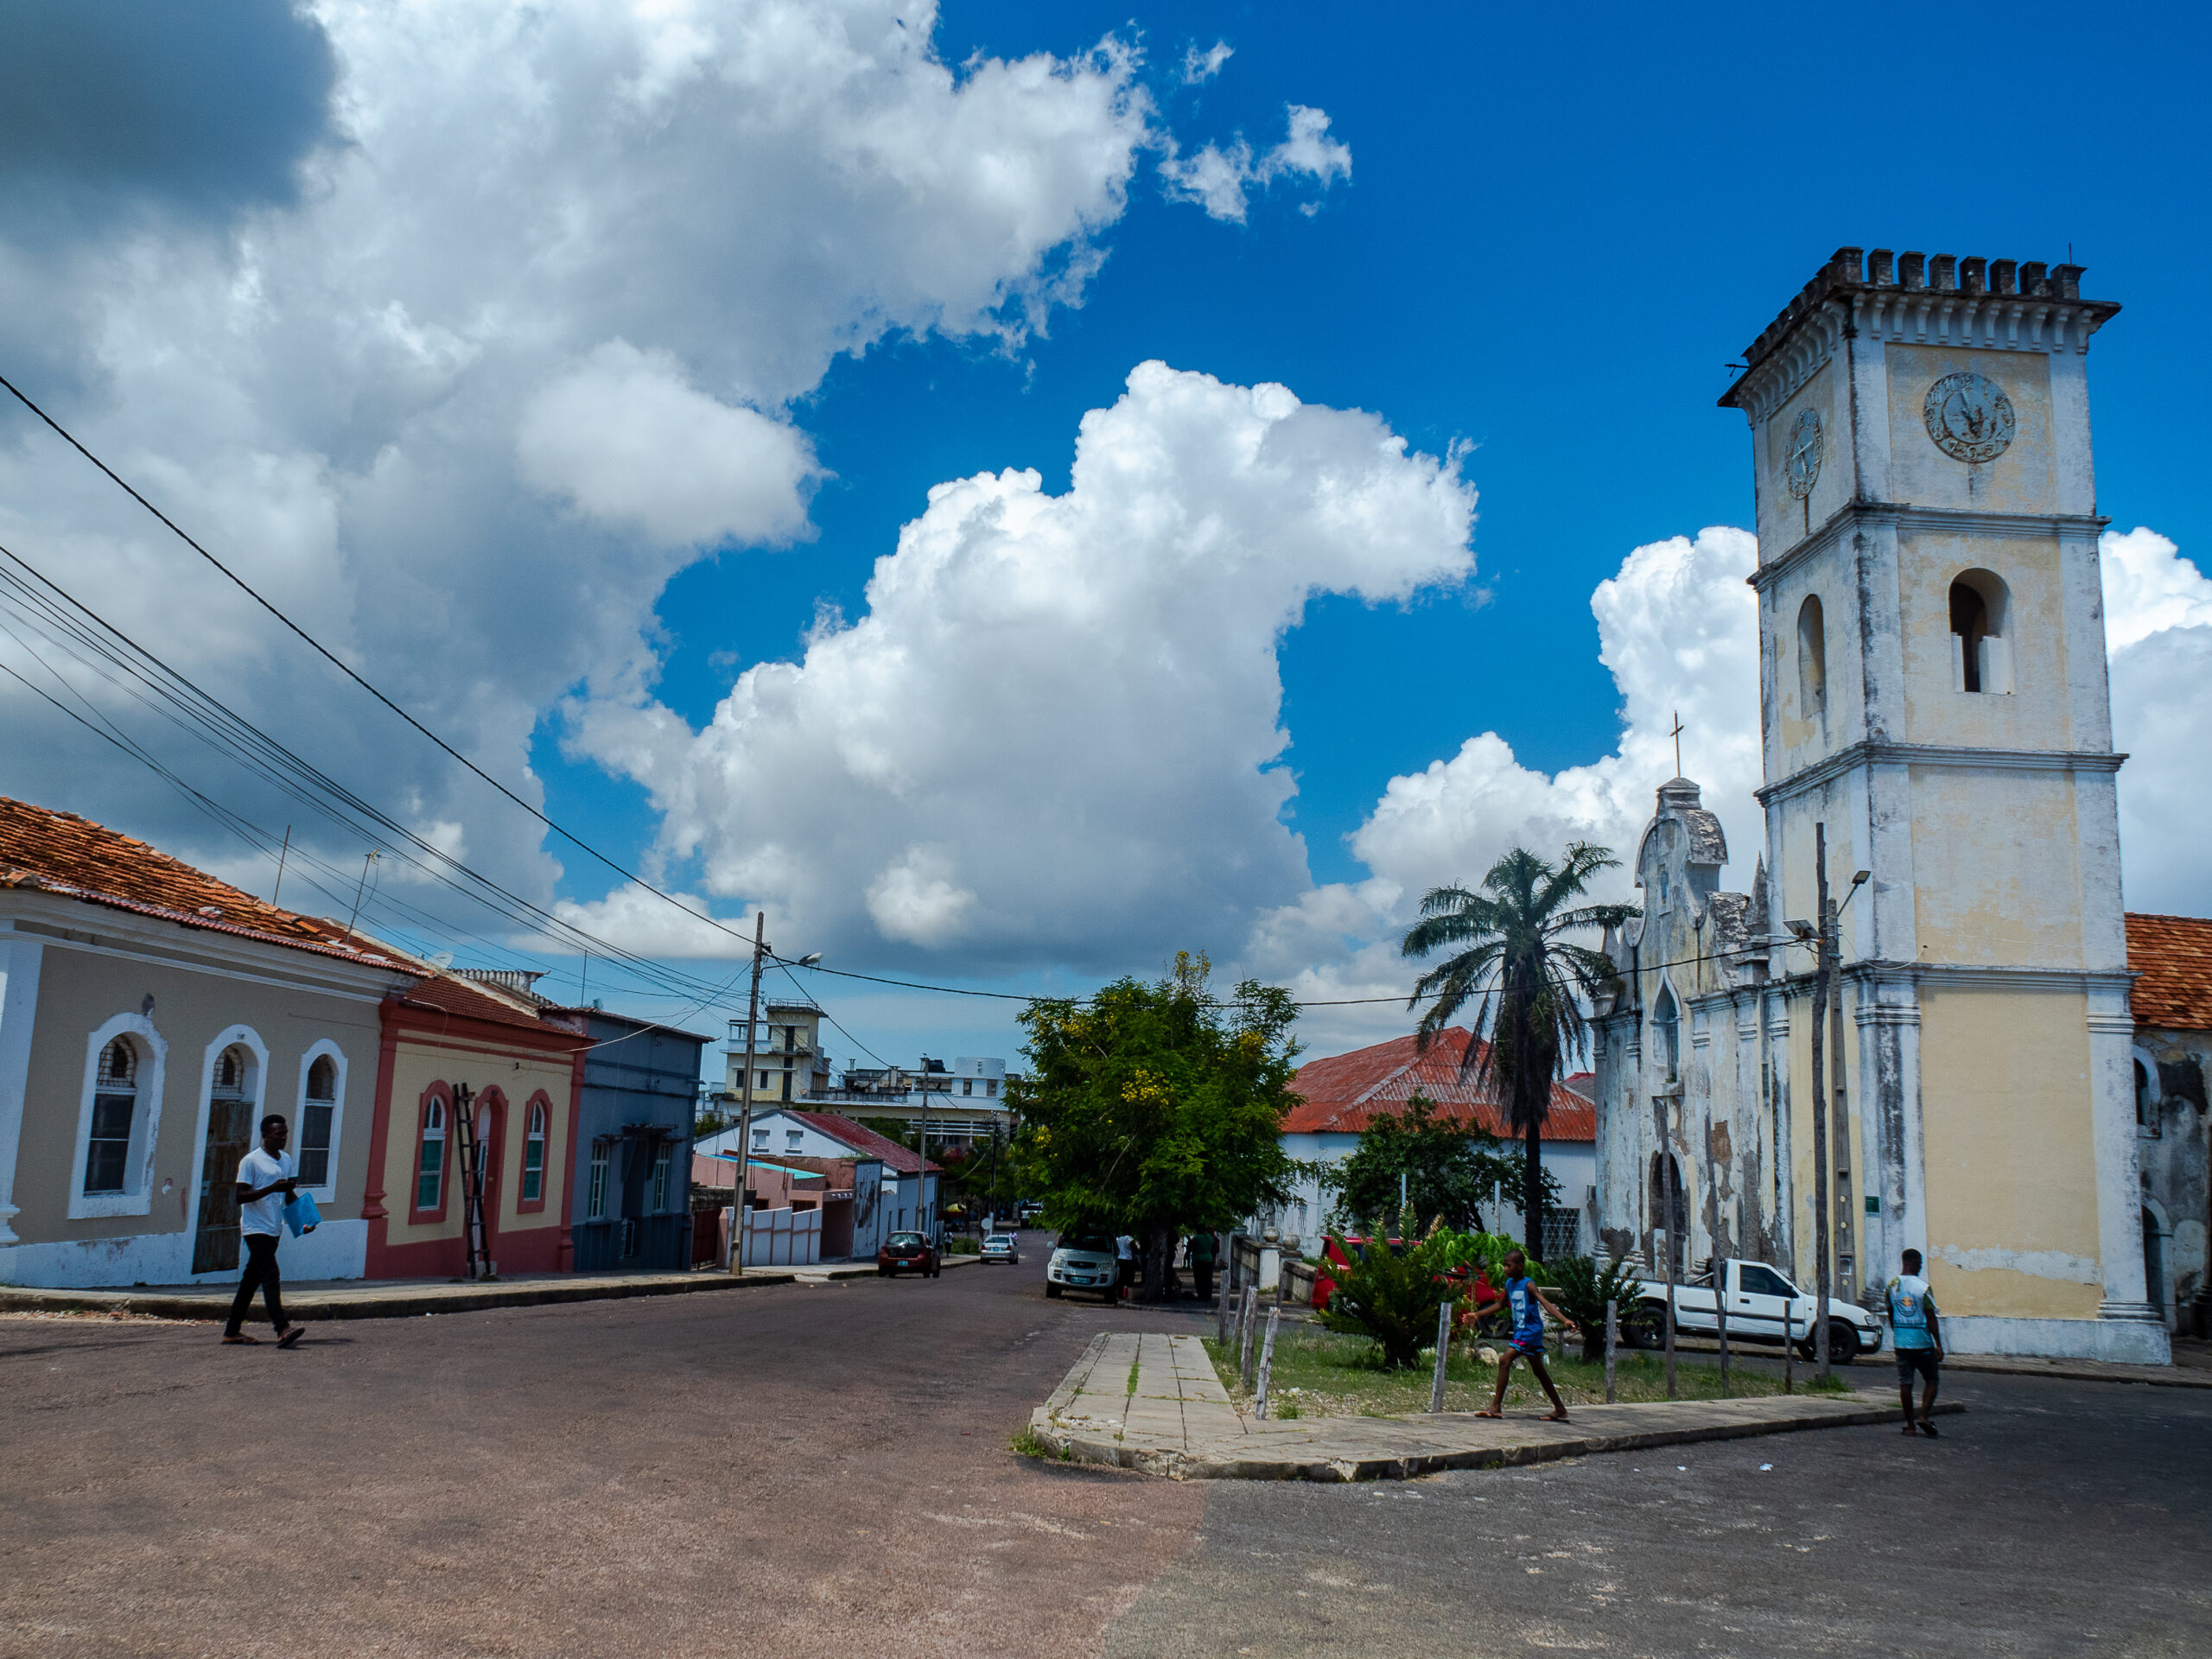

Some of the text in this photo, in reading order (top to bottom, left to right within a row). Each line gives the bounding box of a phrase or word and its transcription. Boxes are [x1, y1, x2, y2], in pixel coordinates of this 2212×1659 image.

[1930, 391, 1942, 405] 10
[1933, 425, 1943, 441] 8
[1948, 440, 1958, 453] 7
[1967, 445, 1977, 461] 6
